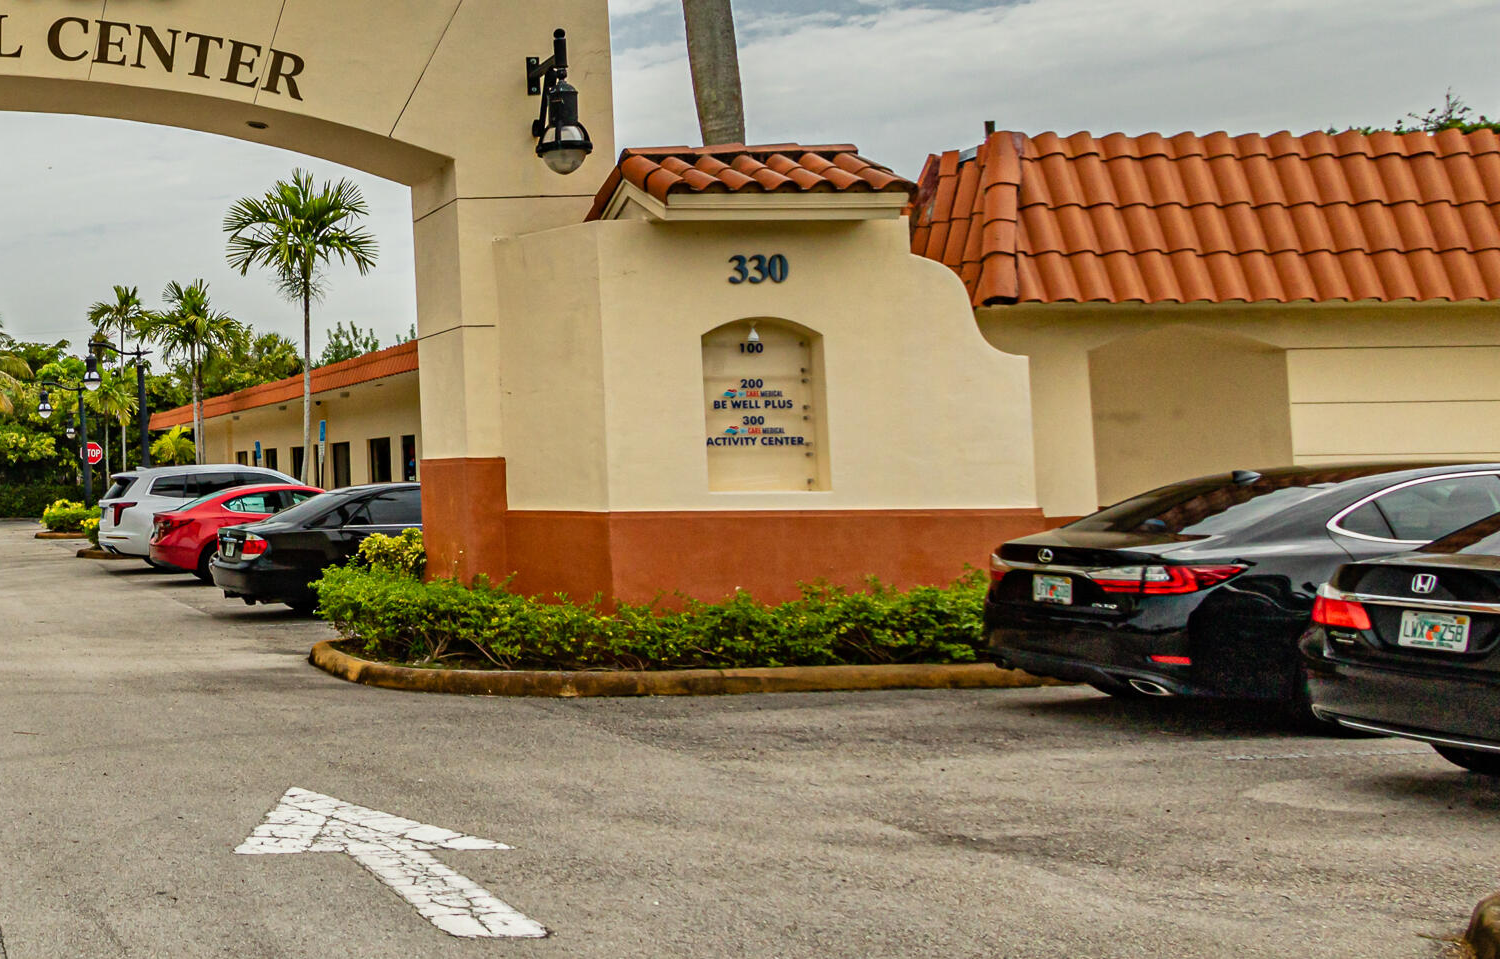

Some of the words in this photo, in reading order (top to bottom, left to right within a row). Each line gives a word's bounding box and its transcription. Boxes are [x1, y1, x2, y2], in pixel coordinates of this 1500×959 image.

[46, 16, 305, 102] CENTER
[728, 253, 789, 285] 330
[739, 342, 764, 354] 100
[740, 378, 764, 389] 200
[713, 400, 728, 409] BE
[731, 400, 761, 409] WELL
[764, 399, 793, 409] PLUS
[742, 415, 765, 426] 300
[706, 436, 757, 446] ACTIVITY
[761, 436, 805, 446] CENTER
[86, 449, 101, 458] TOP
